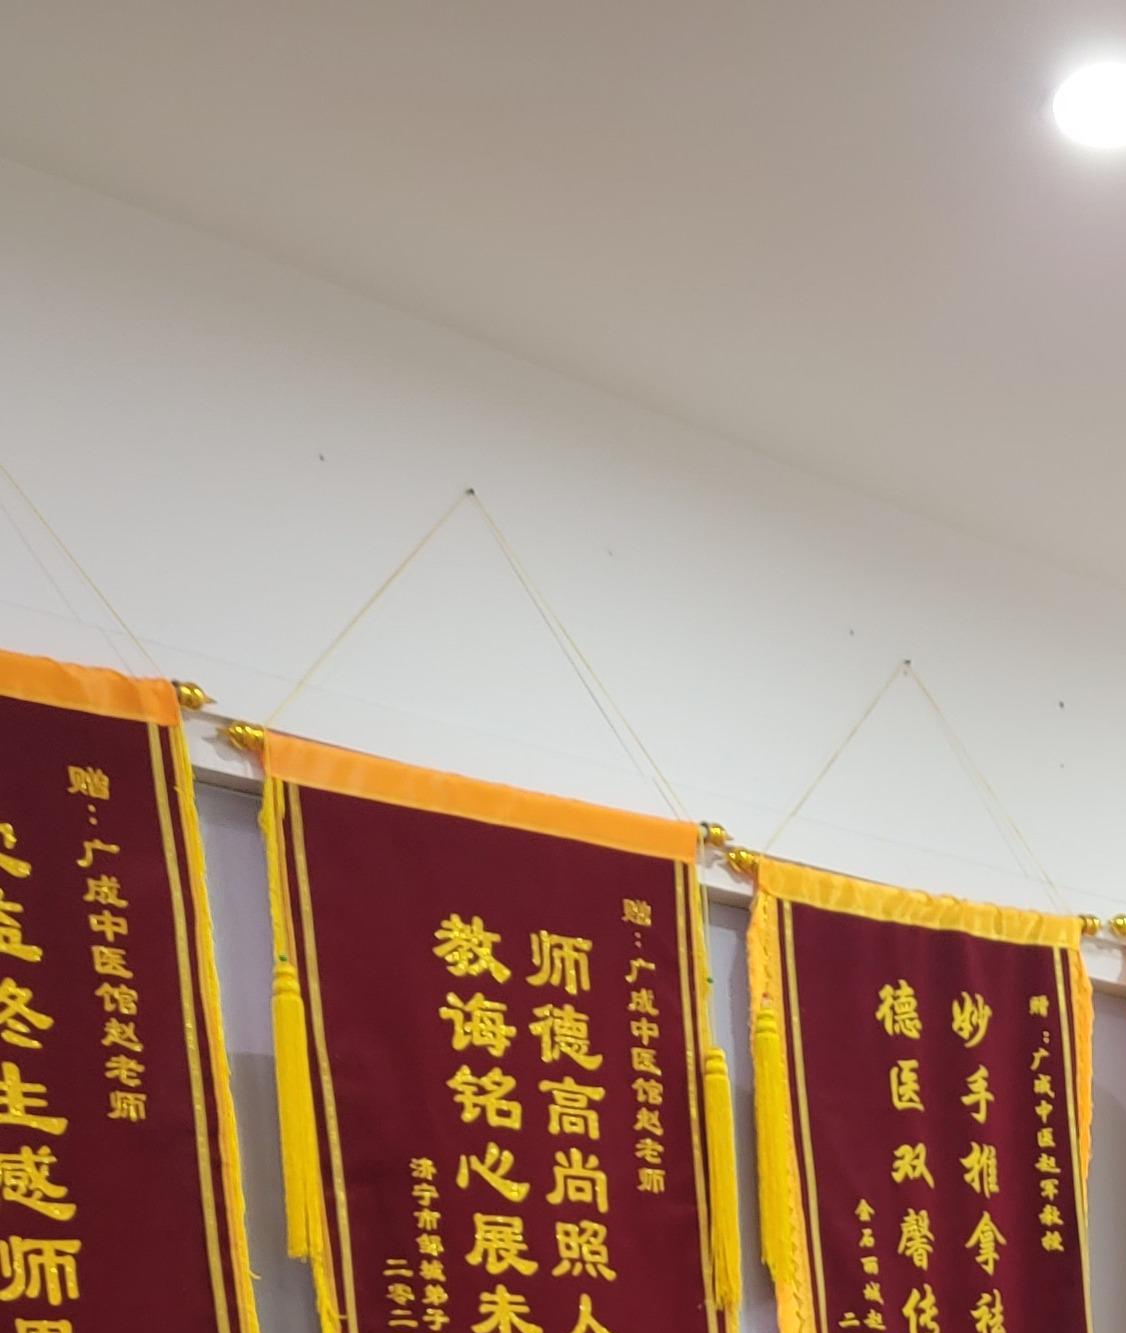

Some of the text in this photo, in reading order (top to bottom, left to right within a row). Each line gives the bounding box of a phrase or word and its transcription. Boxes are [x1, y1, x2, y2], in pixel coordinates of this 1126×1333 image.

[66, 765, 147, 1123] 赠：广成中医馆赵老师
[622, 898, 666, 1194] 赠：广成中医馆赵老师
